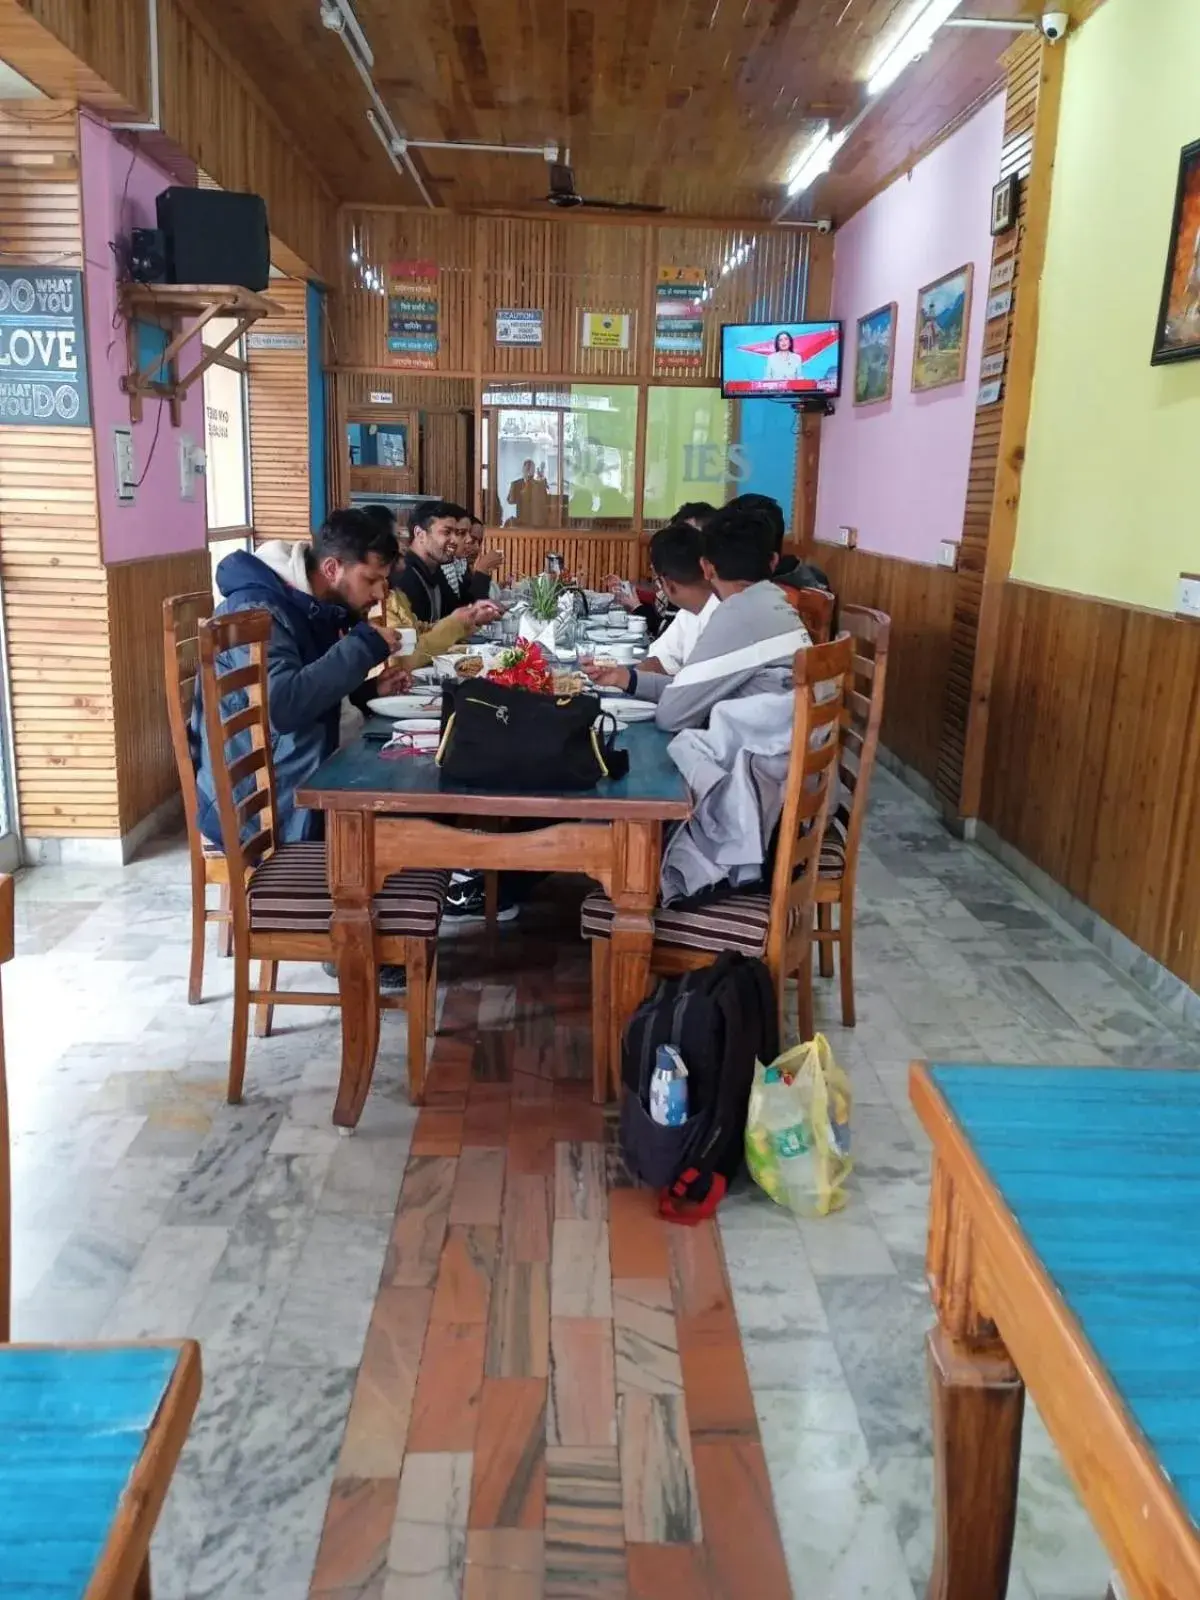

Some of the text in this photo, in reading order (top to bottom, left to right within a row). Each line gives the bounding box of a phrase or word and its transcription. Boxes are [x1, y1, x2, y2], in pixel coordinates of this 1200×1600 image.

[36, 278, 73, 293] WHAT
[37, 293, 74, 313] YOU
[503, 312, 535, 320] CAUTION
[32, 383, 80, 419] DO
